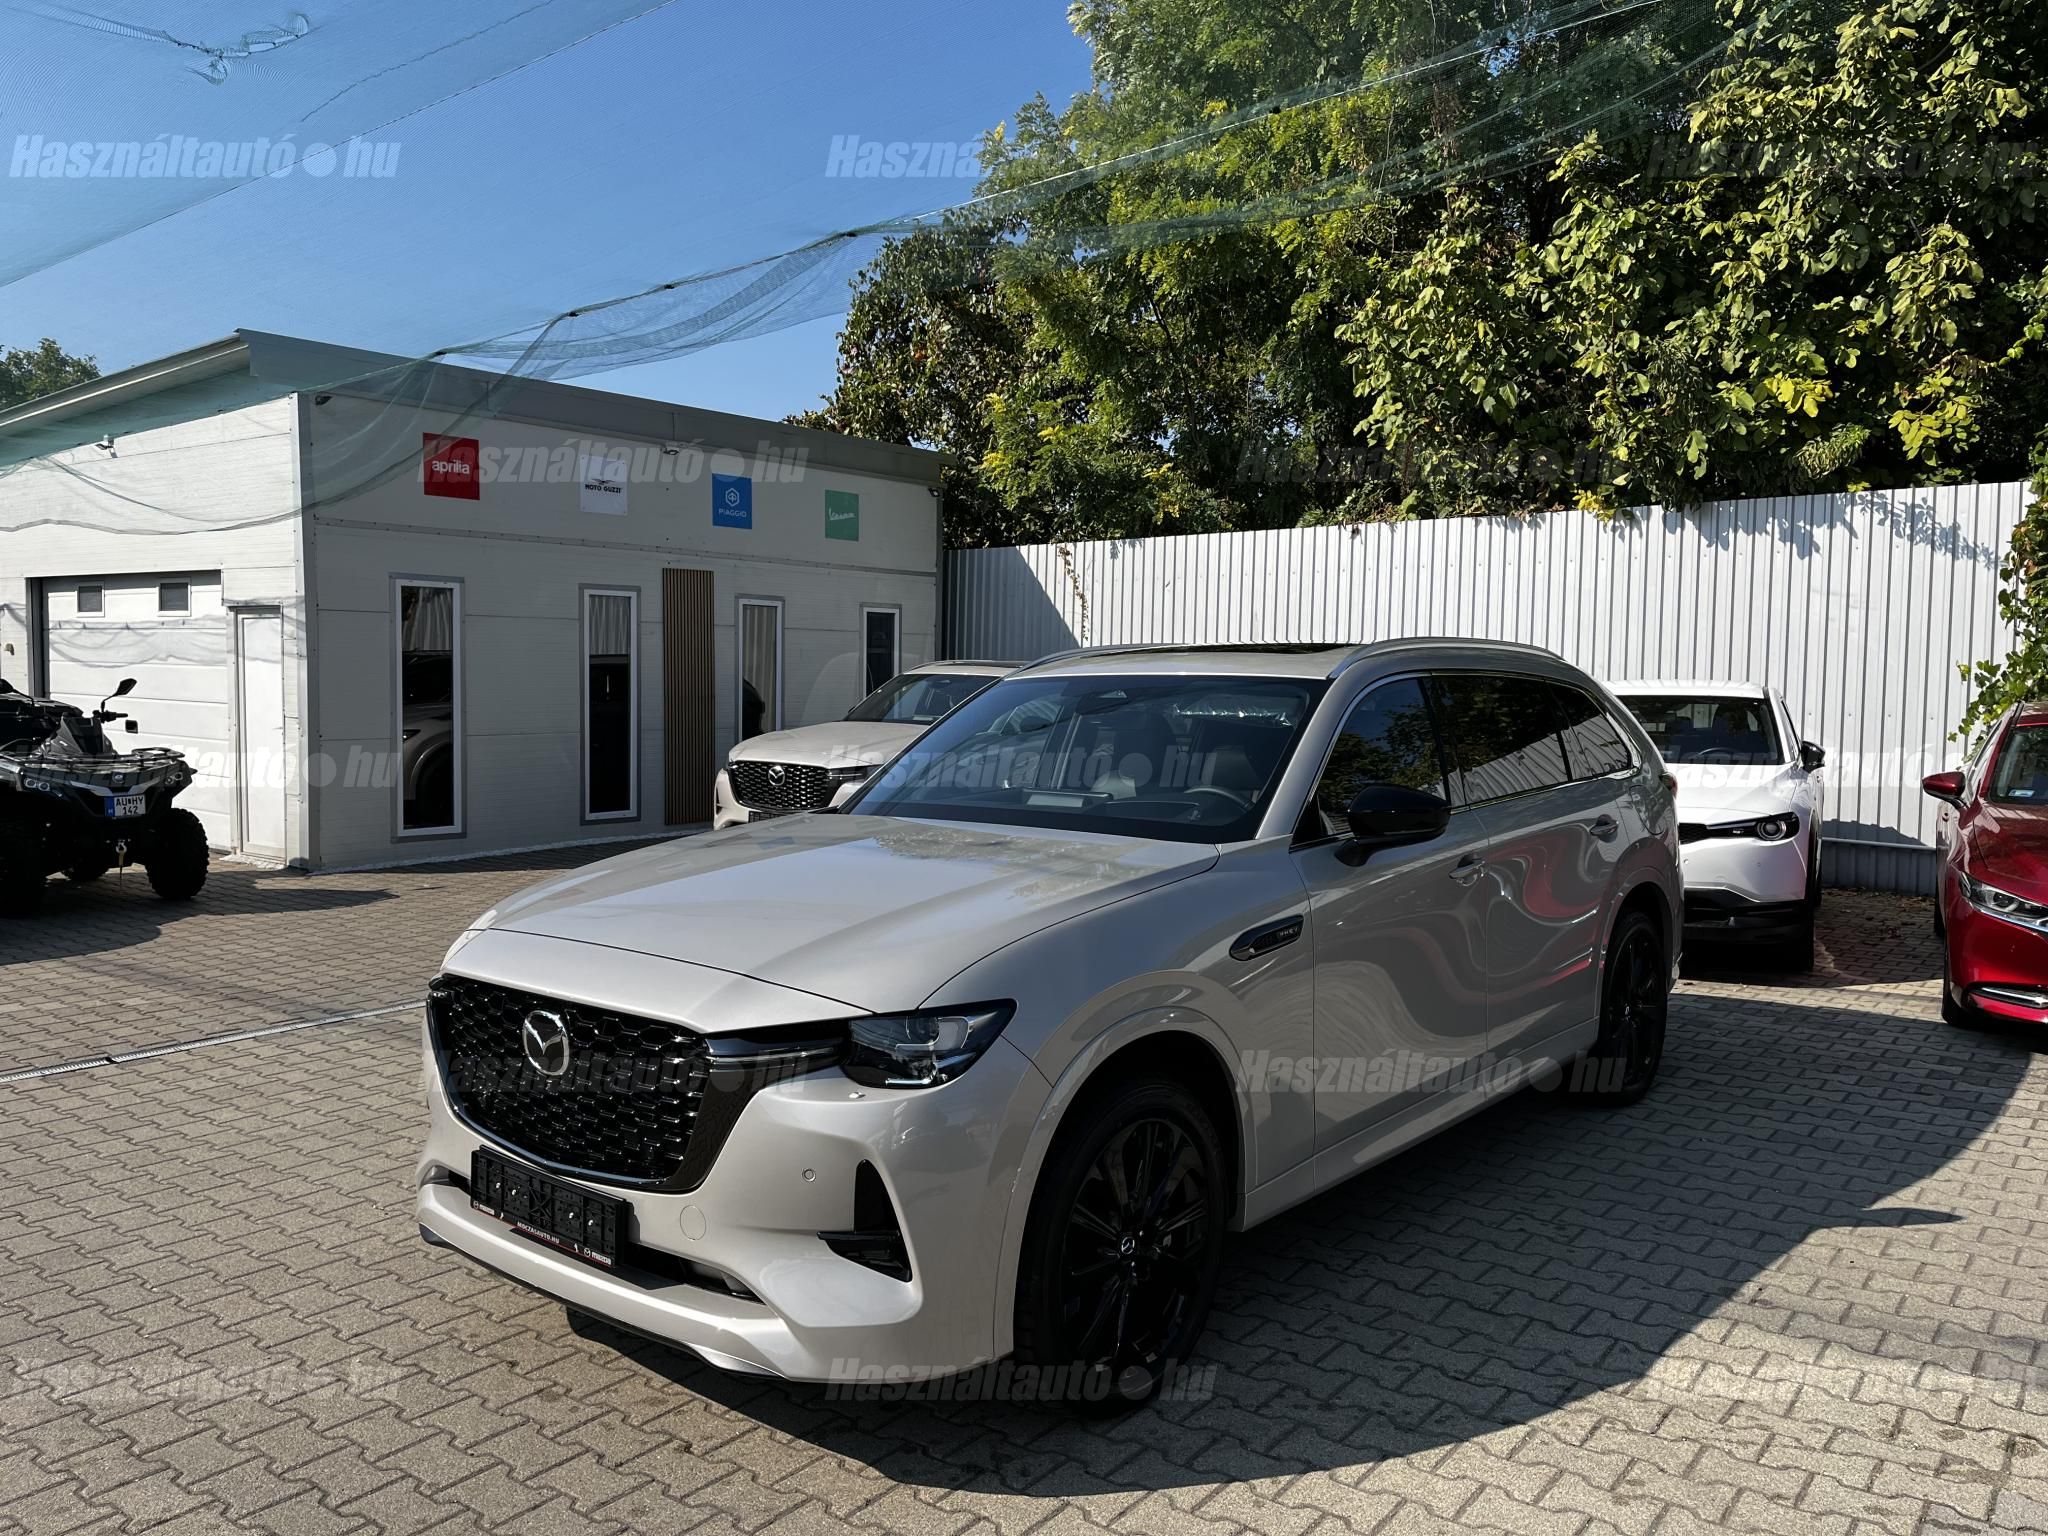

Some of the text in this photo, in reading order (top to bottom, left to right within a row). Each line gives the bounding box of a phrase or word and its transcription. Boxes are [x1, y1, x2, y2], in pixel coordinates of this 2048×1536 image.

[432, 459, 470, 475] aprilia
[584, 483, 622, 494] MOTO GUZZI
[718, 507, 747, 518] PIAGGIO
[123, 806, 138, 815] 142
